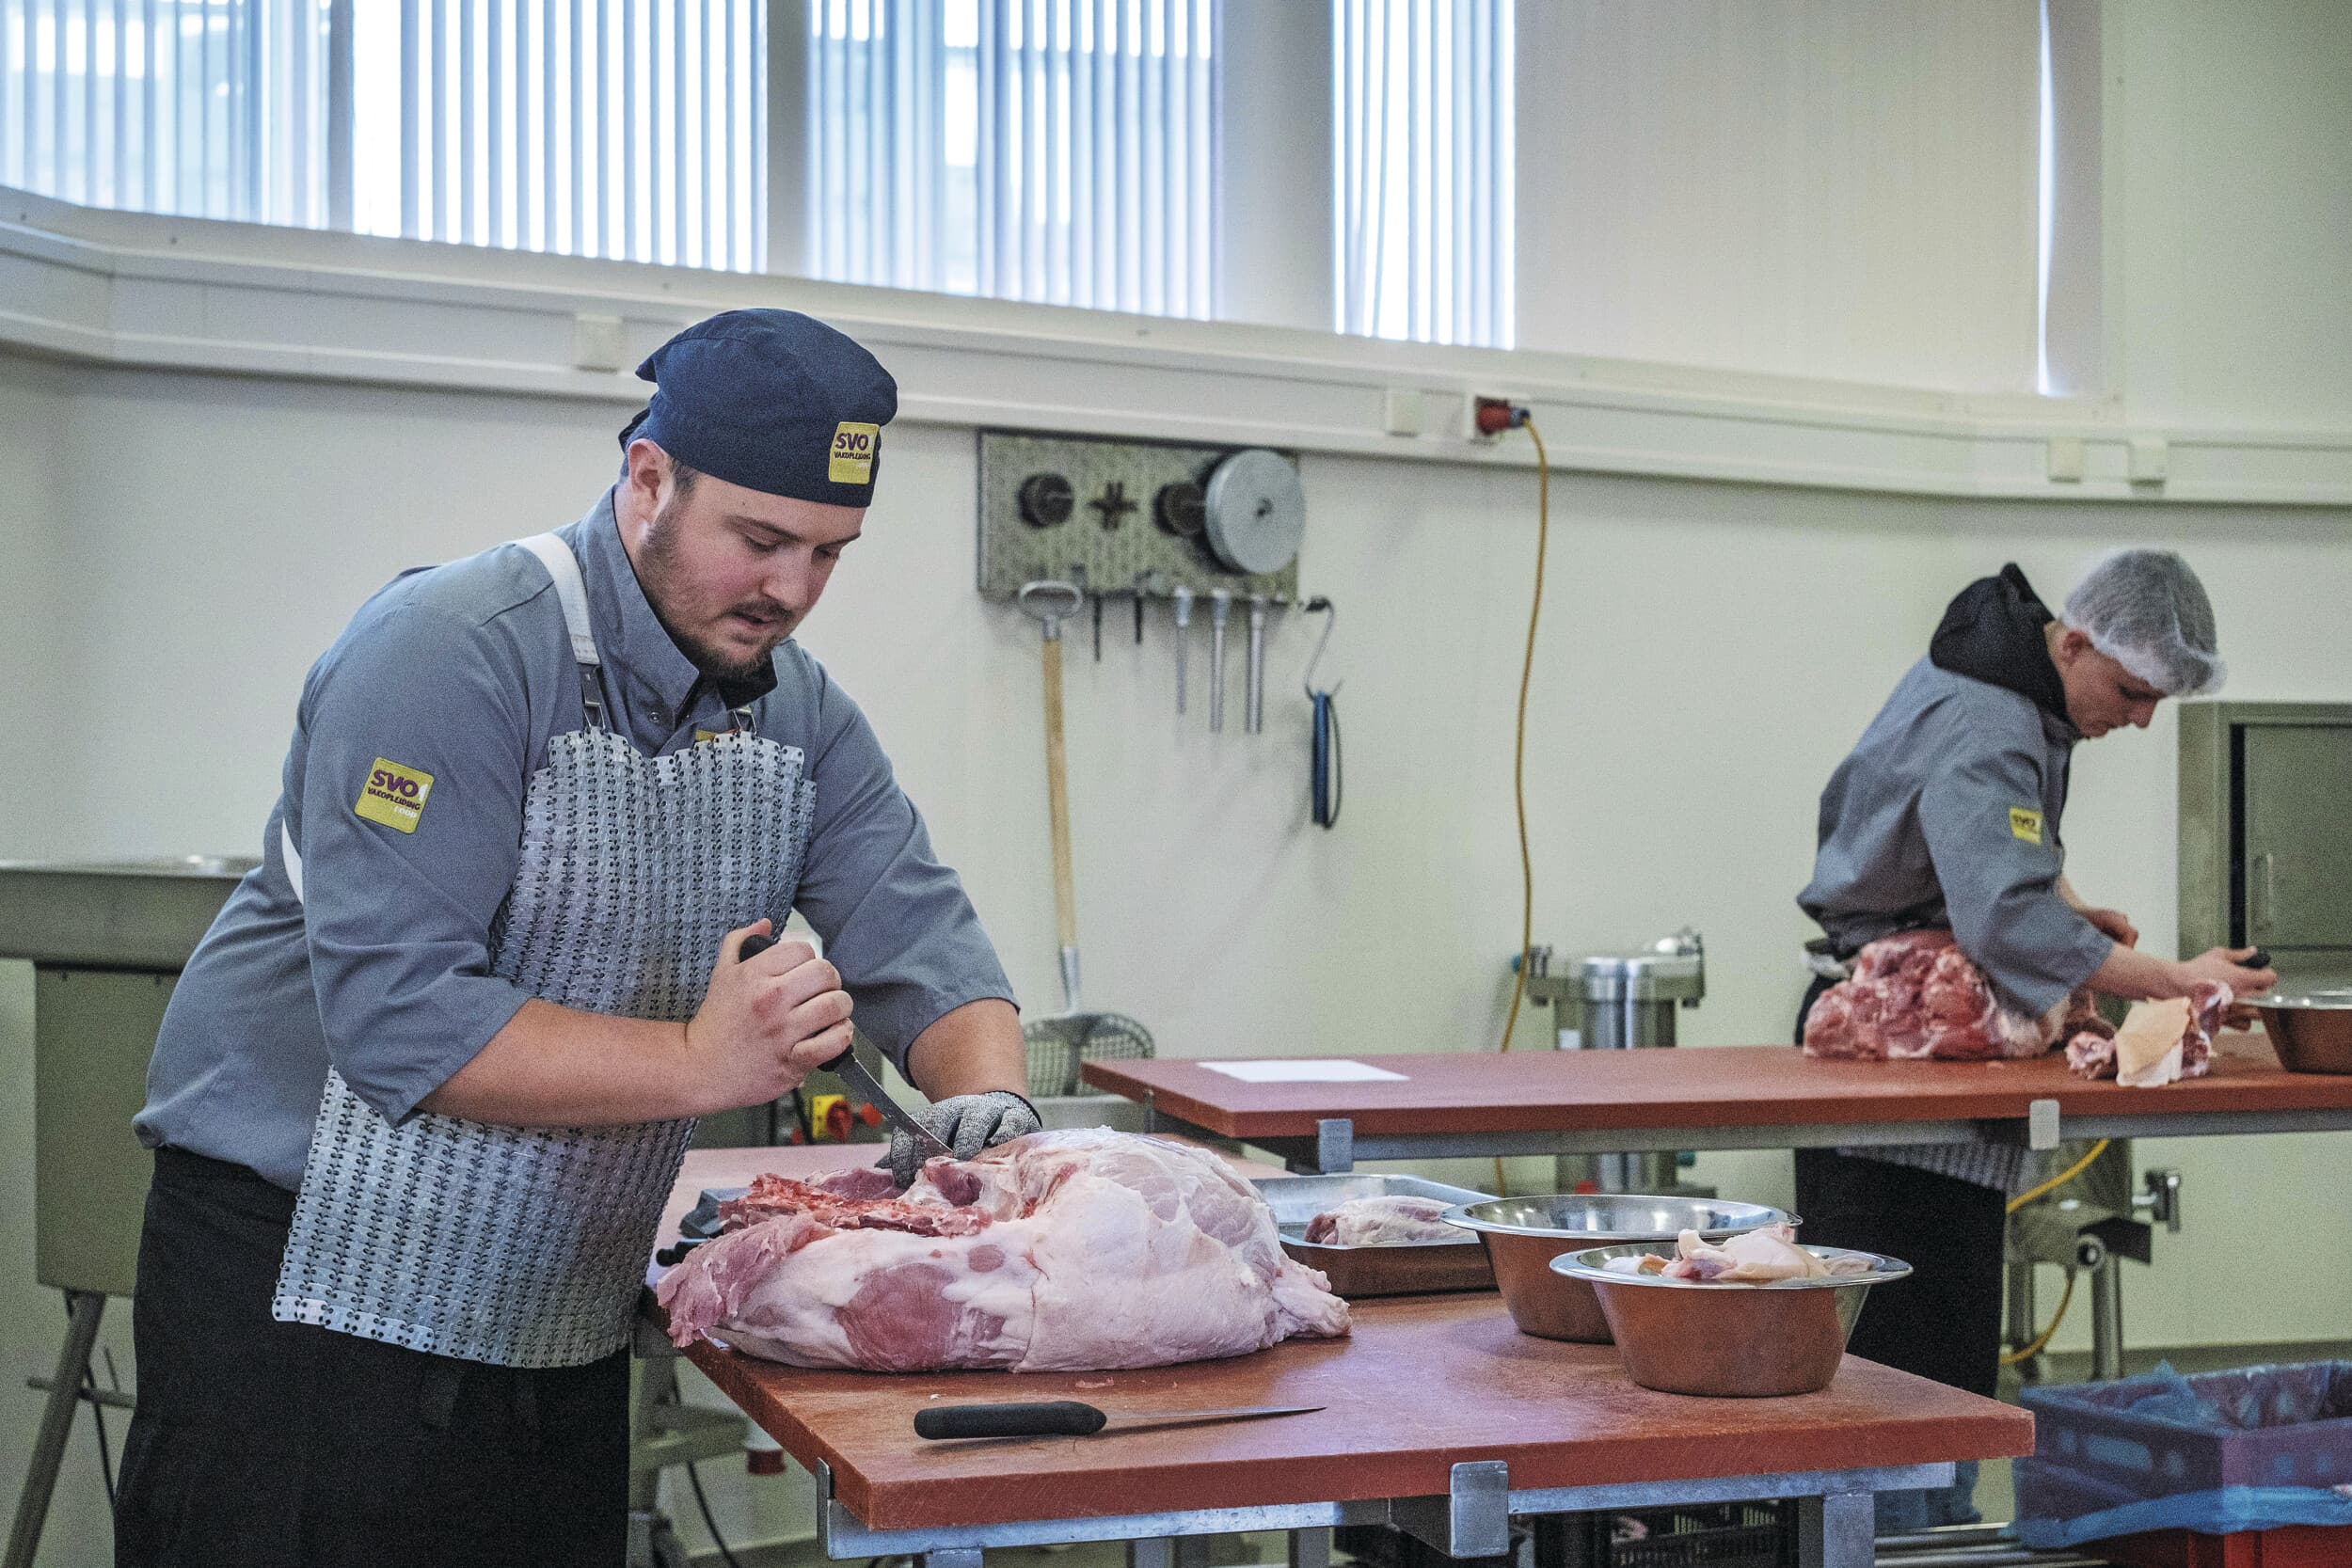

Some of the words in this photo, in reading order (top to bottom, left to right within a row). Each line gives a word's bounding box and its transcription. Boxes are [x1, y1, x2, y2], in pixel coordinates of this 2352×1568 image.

[835, 433, 868, 451] SVO
[371, 769, 419, 798] SVO
[367, 787, 421, 810] VAKOPLEIDING
